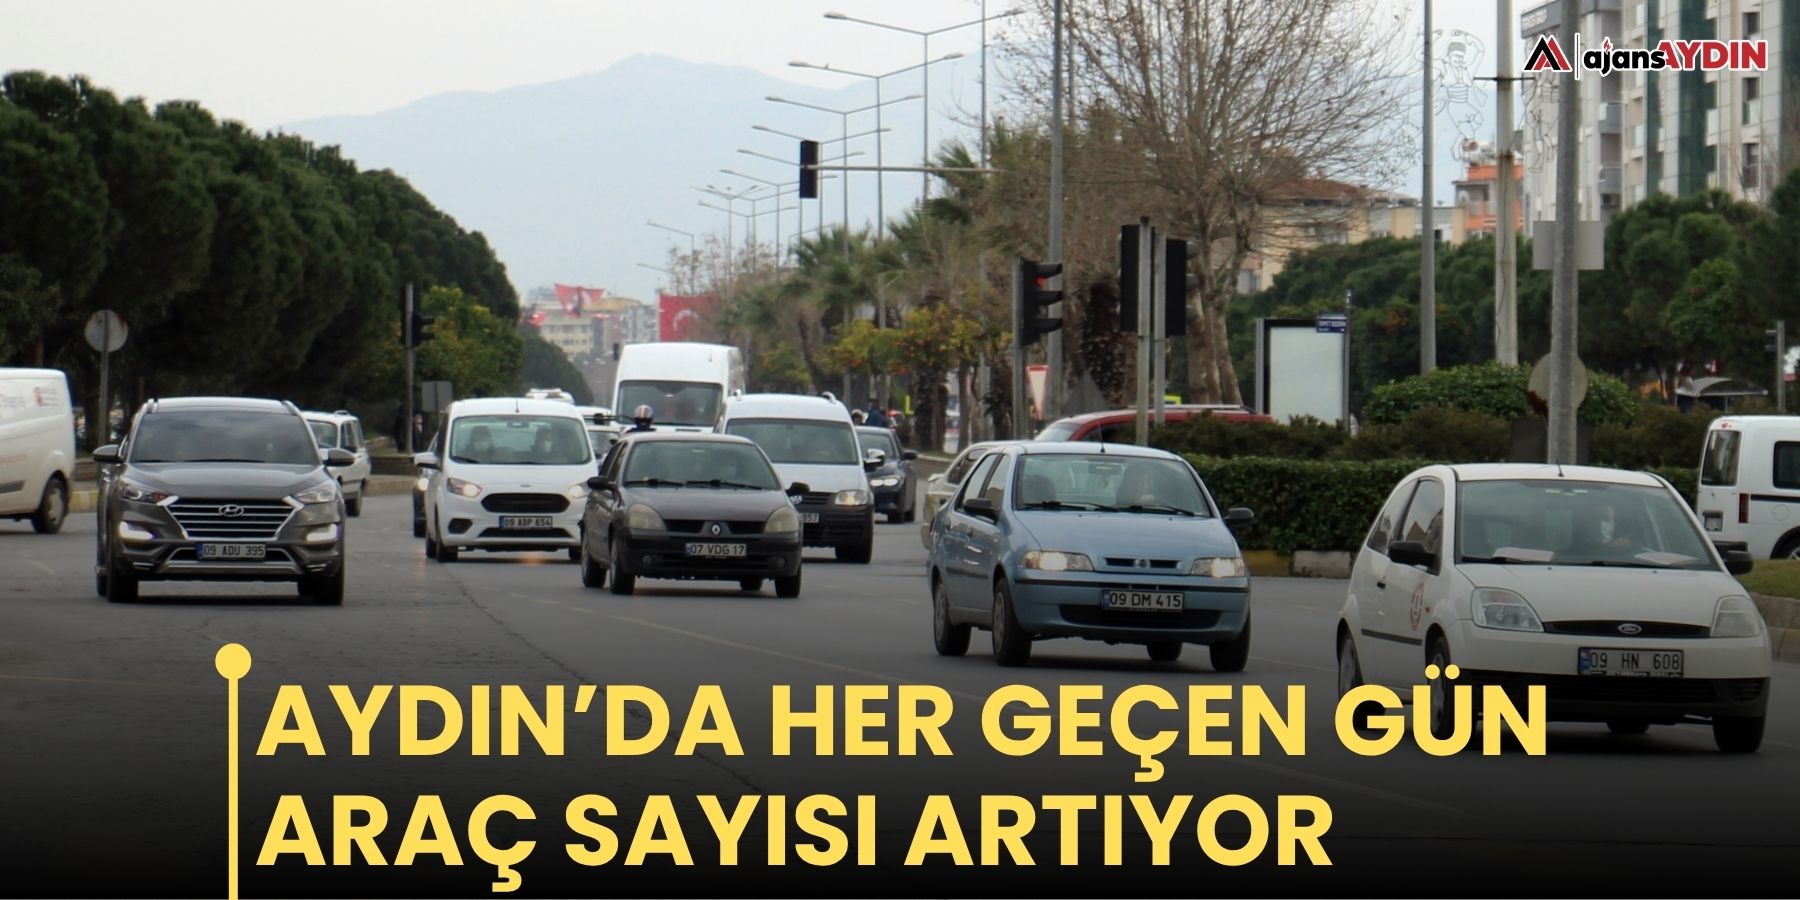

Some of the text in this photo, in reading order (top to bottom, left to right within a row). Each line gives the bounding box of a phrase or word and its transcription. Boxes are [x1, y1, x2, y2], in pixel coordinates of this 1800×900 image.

[203, 545, 264, 556] 09 ADU 395
[690, 544, 745, 555] 07 VDG 17
[1110, 592, 1181, 608] 09 DM 415
[1590, 652, 1680, 670] 09 HN 608
